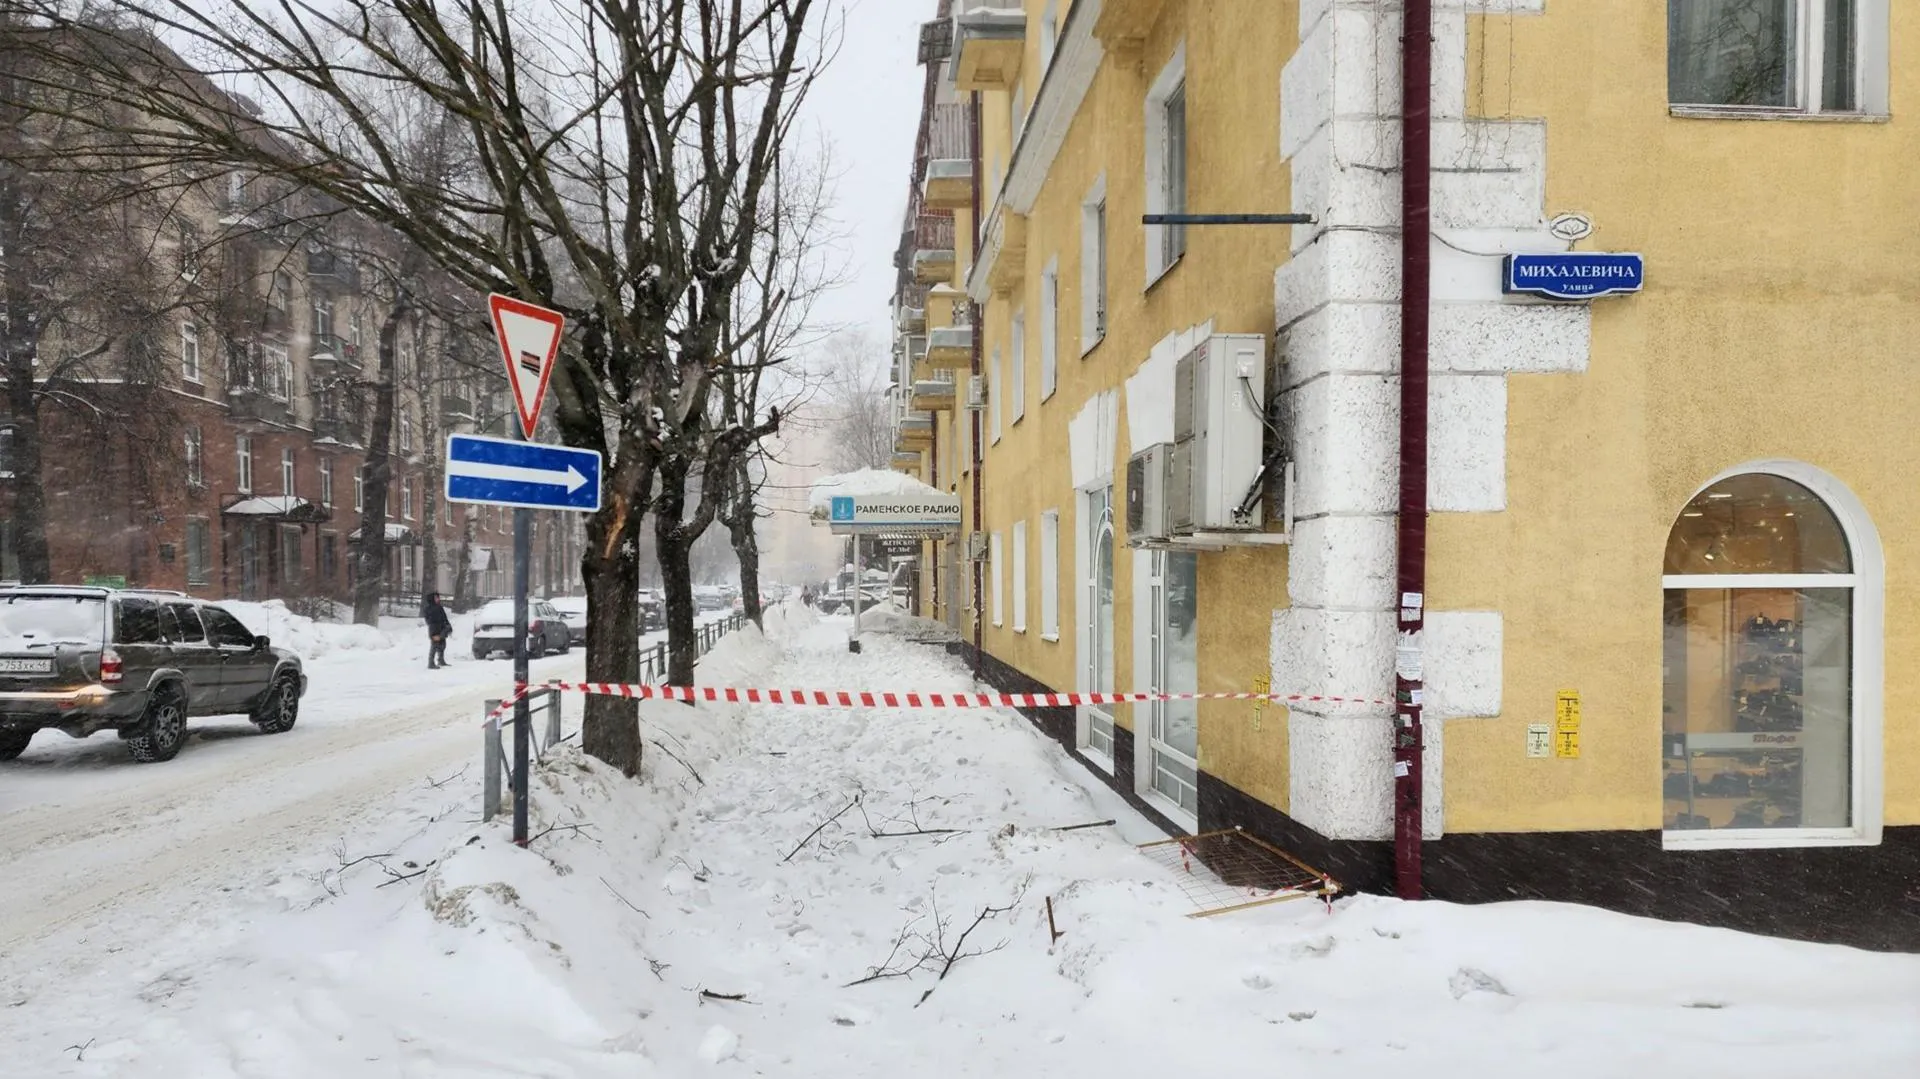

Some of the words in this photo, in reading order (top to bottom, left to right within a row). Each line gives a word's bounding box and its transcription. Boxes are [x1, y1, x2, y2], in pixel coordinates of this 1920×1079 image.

[1520, 265, 1635, 278] МИХАЛЕВИЧА
[855, 504, 921, 514] РАМЕНСКОЕ
[923, 504, 960, 515] РАДИО
